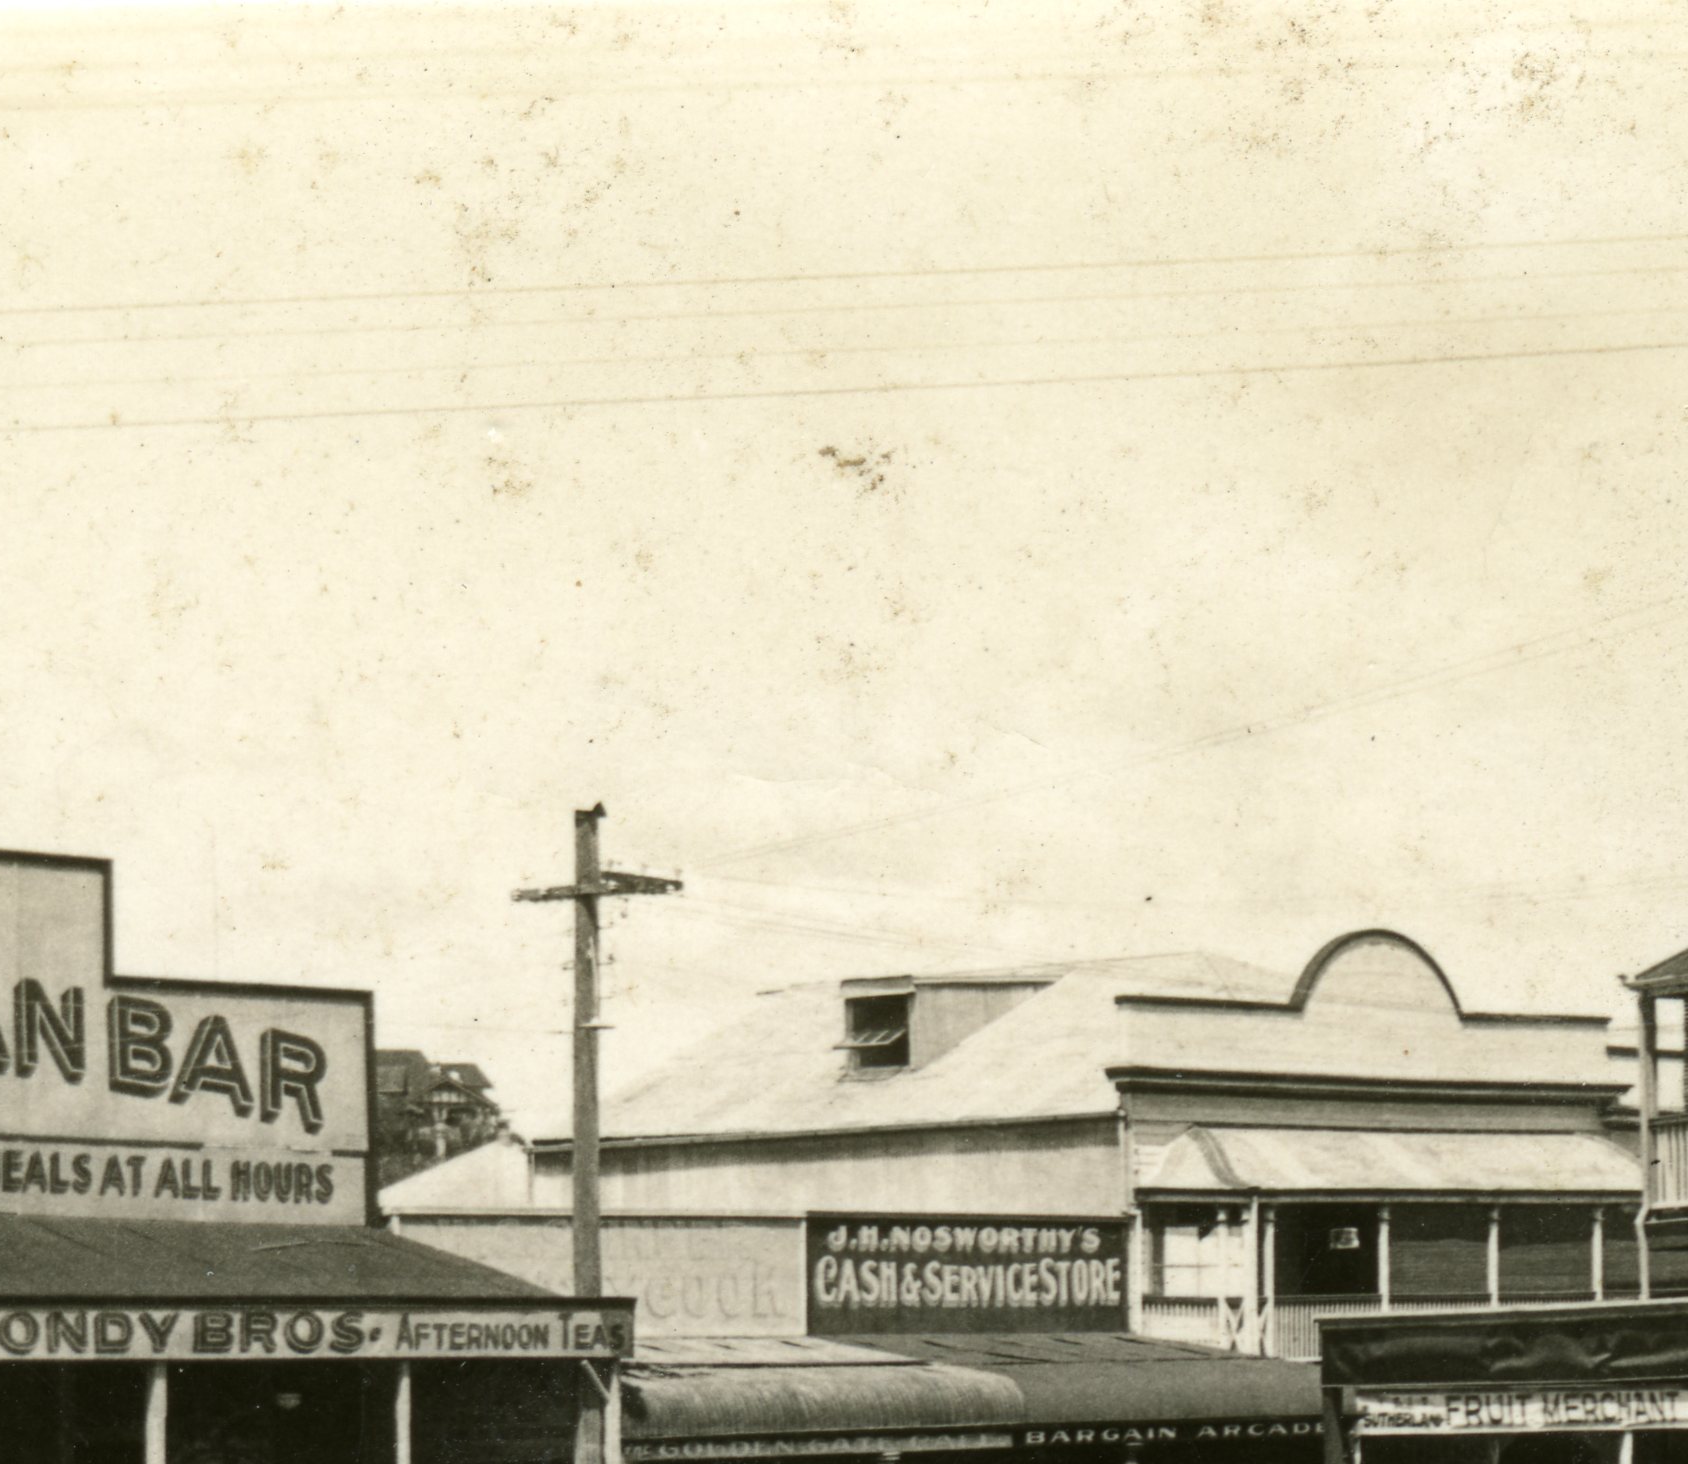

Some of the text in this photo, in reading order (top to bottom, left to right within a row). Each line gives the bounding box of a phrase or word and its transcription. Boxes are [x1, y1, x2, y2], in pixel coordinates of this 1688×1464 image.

[105, 995, 329, 1134] BAR
[100, 1154, 147, 1198] AT
[153, 1157, 222, 1201] ALL
[230, 1160, 335, 1205] HOURS
[813, 1254, 897, 1308] CASH
[922, 1260, 1038, 1308] SERVICE
[1037, 1256, 1121, 1307] STORE
[396, 1310, 550, 1352] AFTERNOON
[558, 1311, 625, 1352] TEAS
[1445, 1390, 1679, 1427] FRUIT MERCHANT
[1025, 1427, 1177, 1445] BARGAIN
